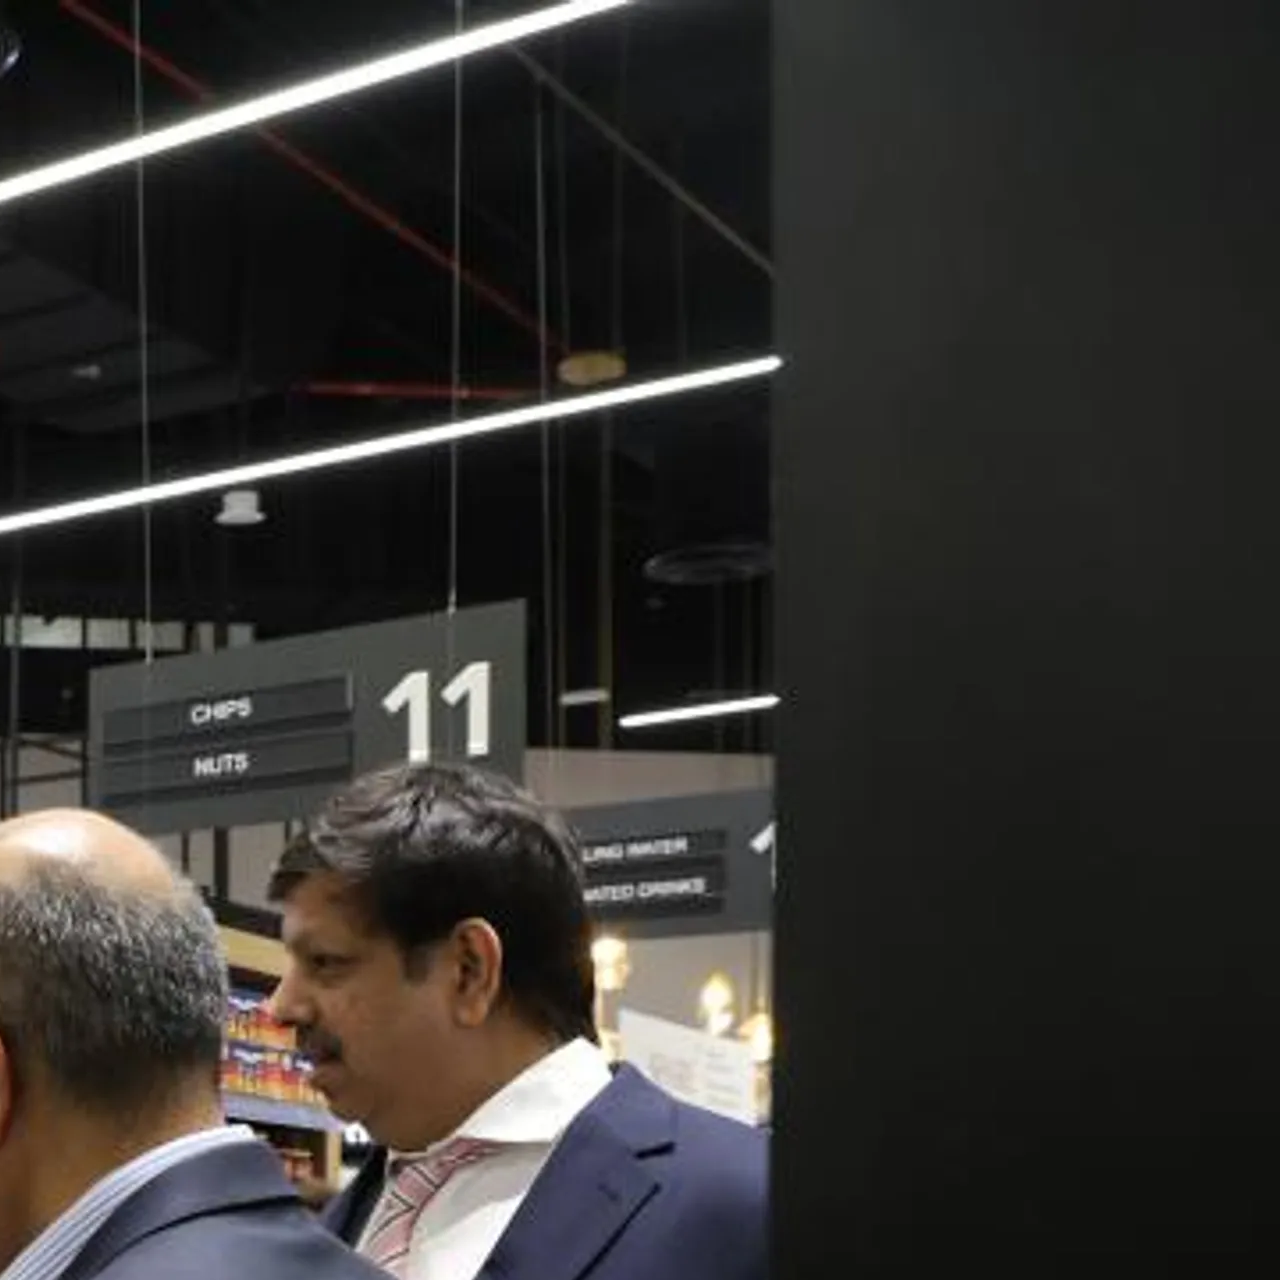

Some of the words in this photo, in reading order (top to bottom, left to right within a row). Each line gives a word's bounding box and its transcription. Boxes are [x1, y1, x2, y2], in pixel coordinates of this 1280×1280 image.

[190, 696, 253, 726] CHIPS
[382, 661, 491, 765] 11
[192, 752, 249, 779] NUTS
